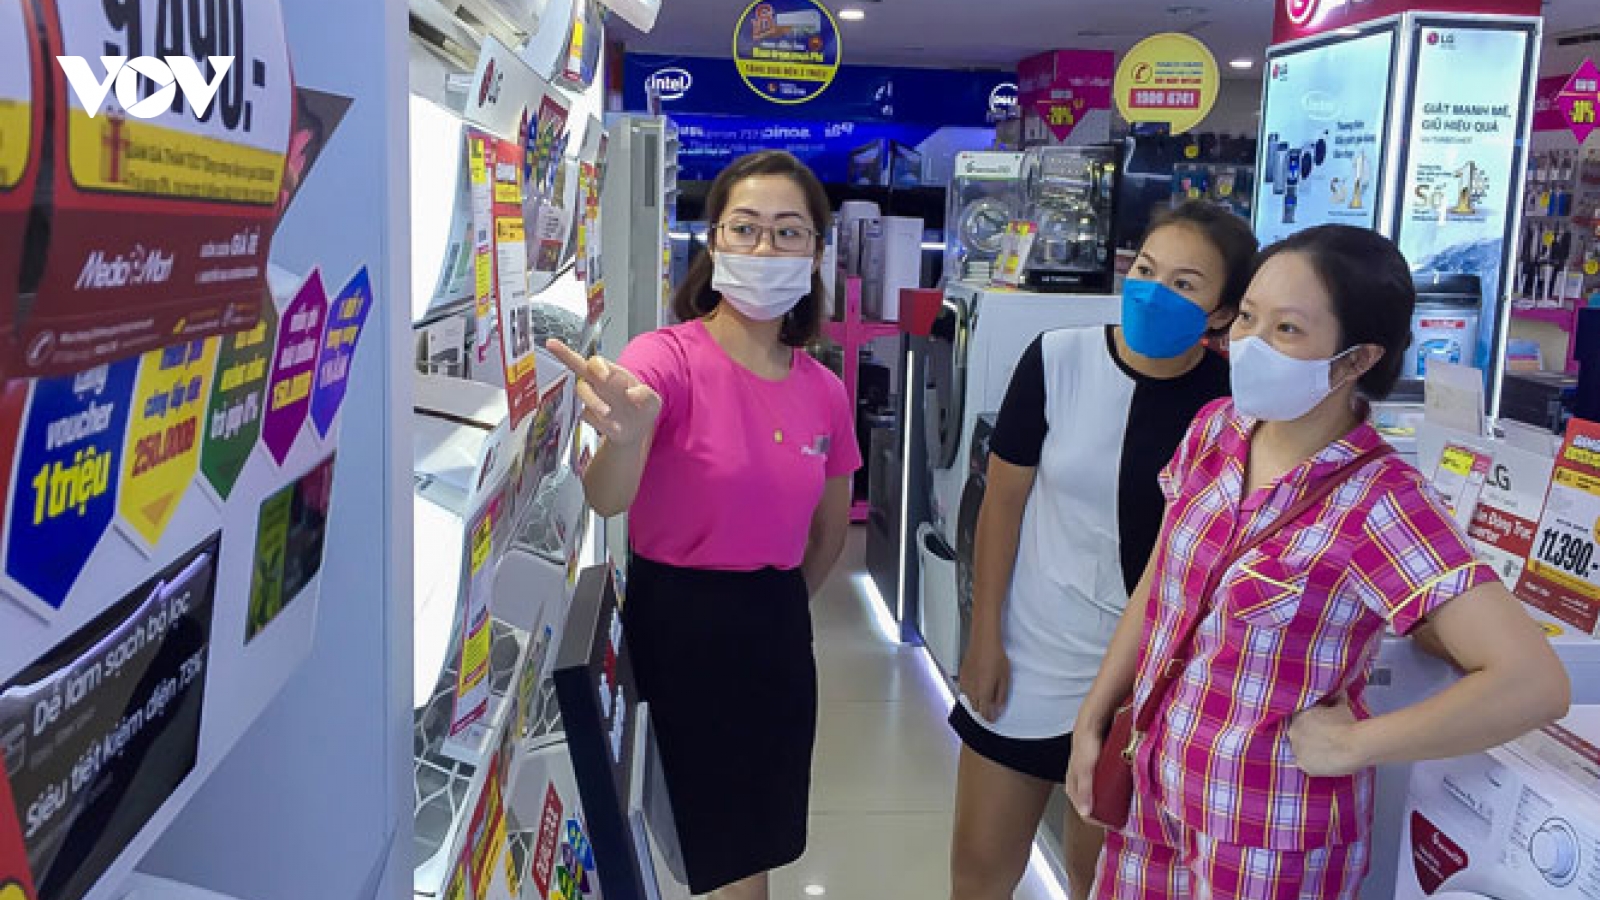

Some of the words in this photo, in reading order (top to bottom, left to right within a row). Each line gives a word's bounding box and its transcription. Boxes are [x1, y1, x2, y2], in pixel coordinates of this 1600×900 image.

[46, 402, 114, 451] voucher
[32, 463, 51, 526] 1
[47, 446, 112, 518] triệu
